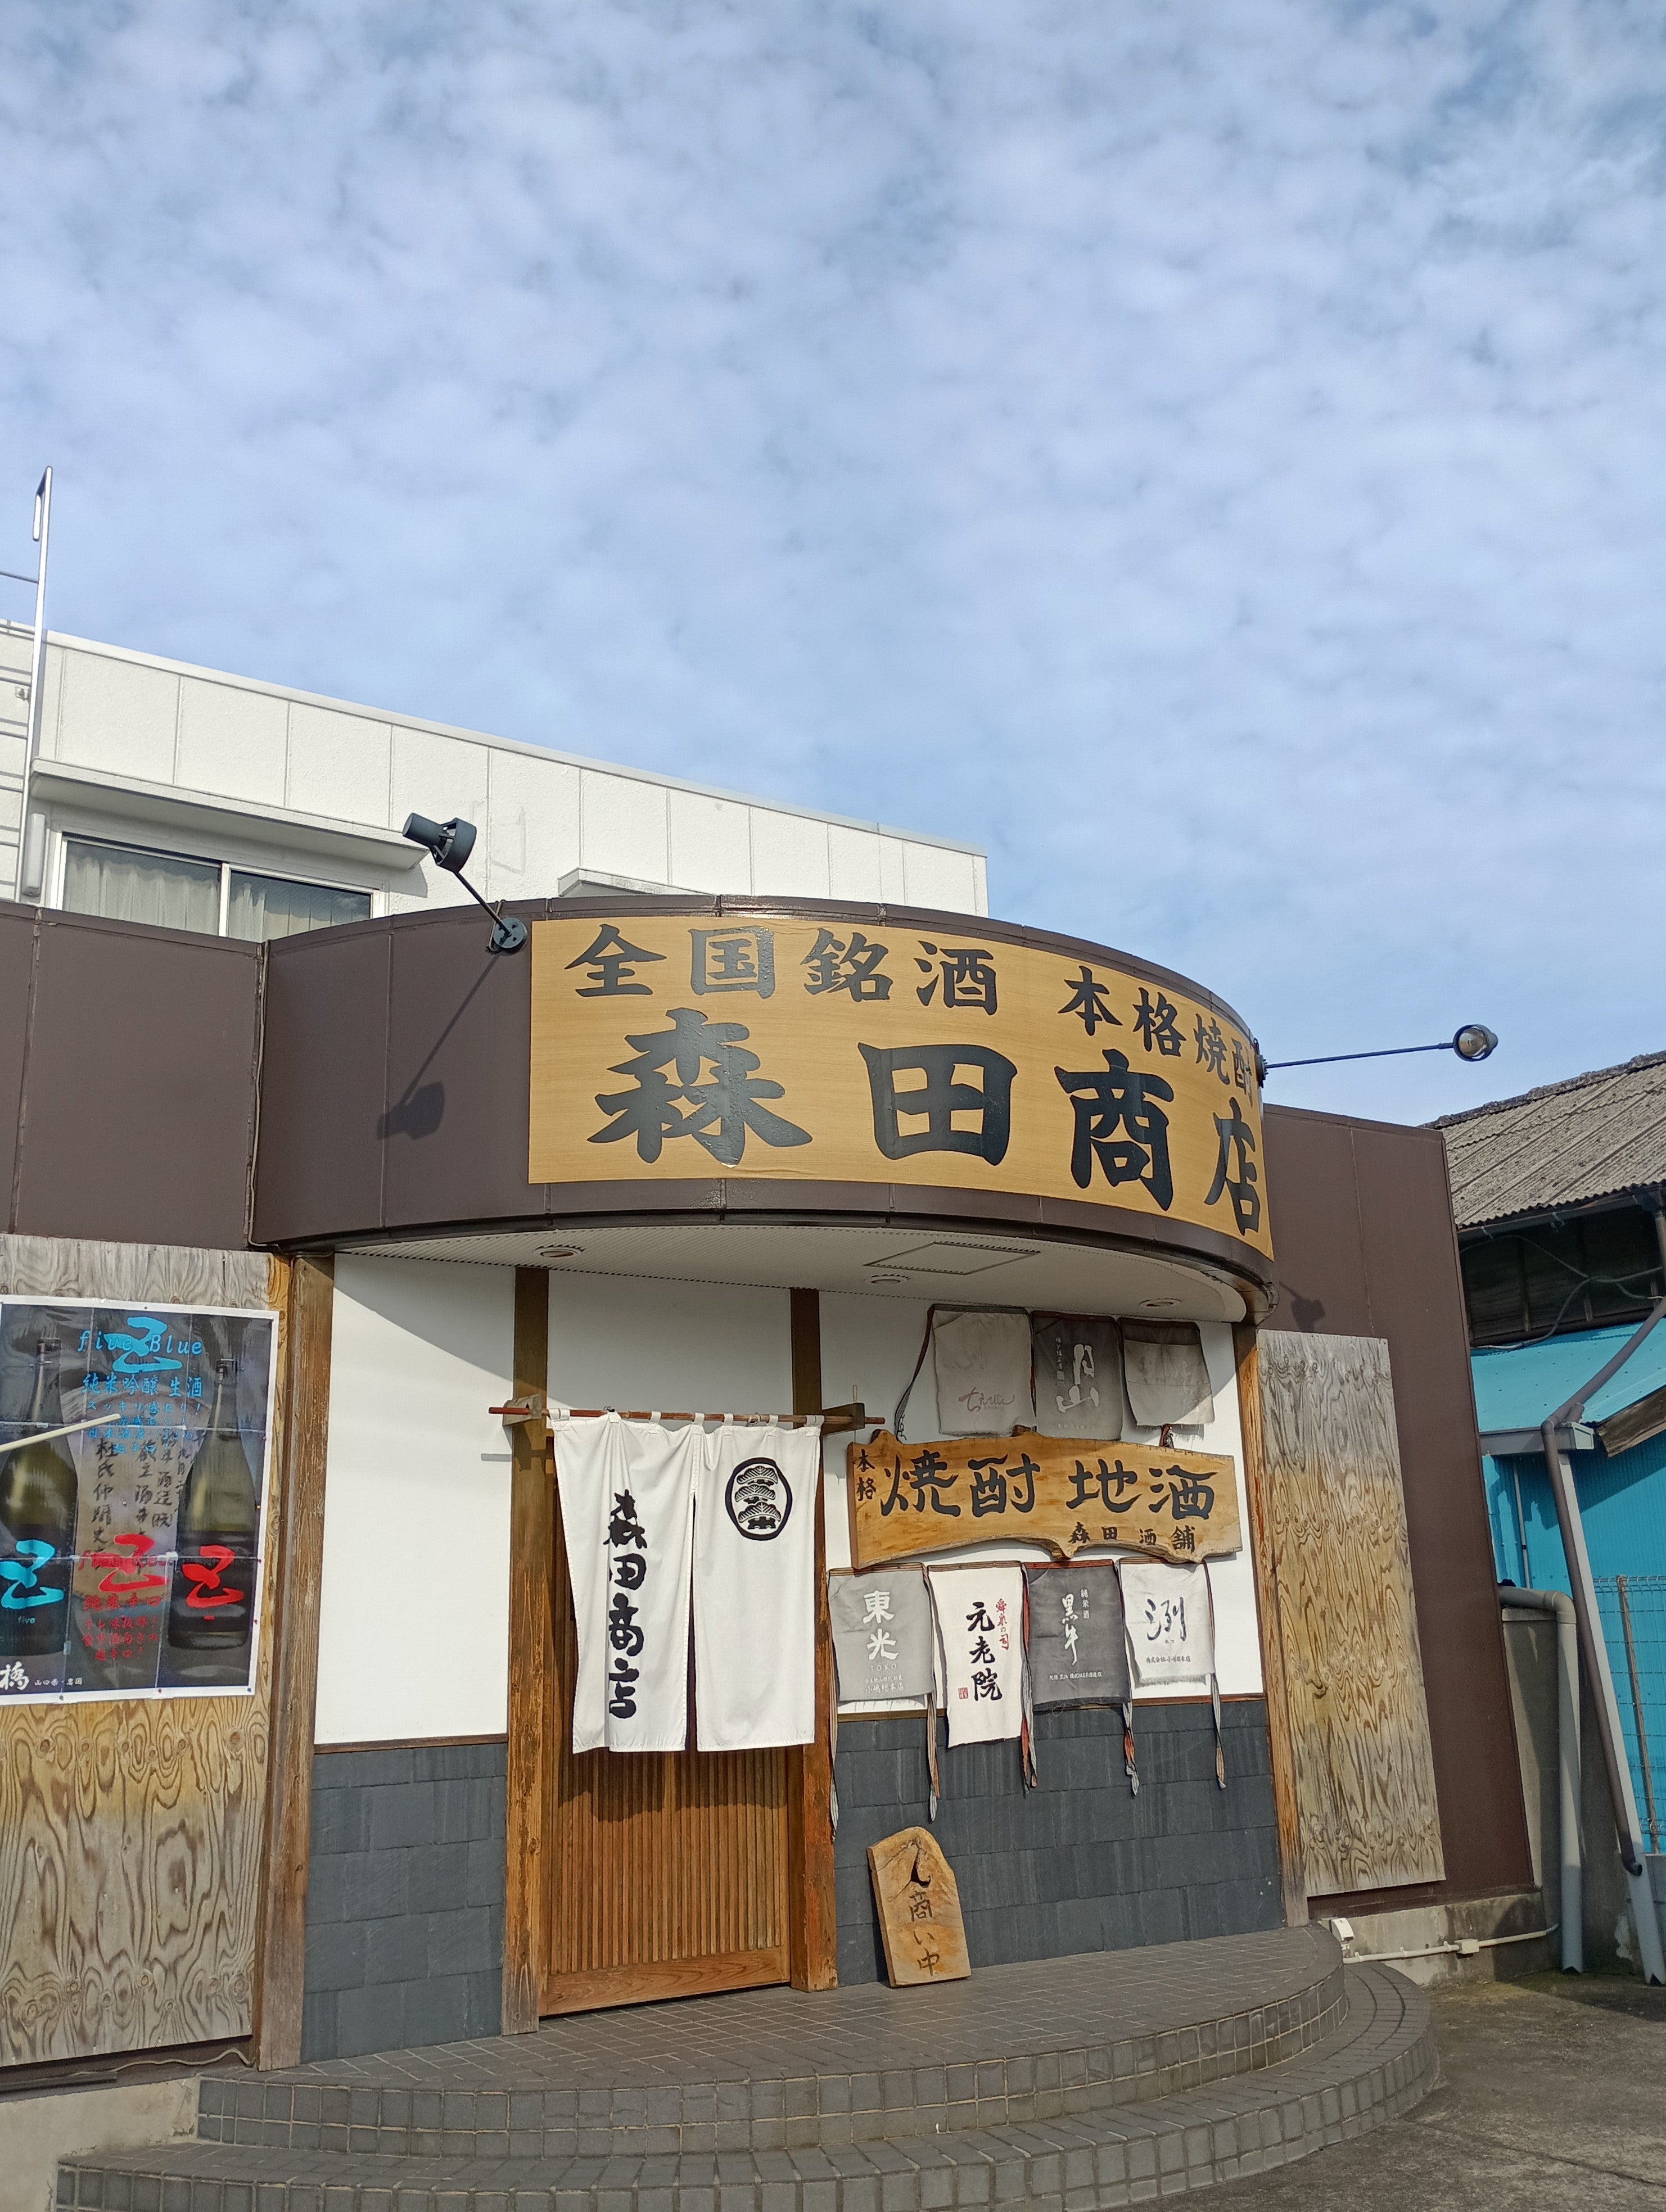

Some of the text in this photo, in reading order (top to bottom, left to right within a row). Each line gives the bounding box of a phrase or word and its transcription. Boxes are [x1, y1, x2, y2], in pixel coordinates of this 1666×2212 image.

[564, 923, 1253, 1107] 全国銘酒 本格焼酎
[587, 1007, 1261, 1236] 森田商店
[78, 1330, 203, 1354] five Blue
[82, 1372, 202, 1398] 純米吟醸 生酒
[856, 1449, 877, 1501] 本格
[880, 1449, 1219, 1519] 焼酎 地酒
[1068, 1522, 1195, 1553] 森田酒舗
[83, 1592, 162, 1611] 純米辛口
[863, 1590, 899, 1660] 東光
[1062, 1593, 1078, 1666] 黒牛
[1081, 1589, 1090, 1620] 純米酒
[966, 1602, 1003, 1701] 元老院
[909, 1890, 940, 1976] 商い中
